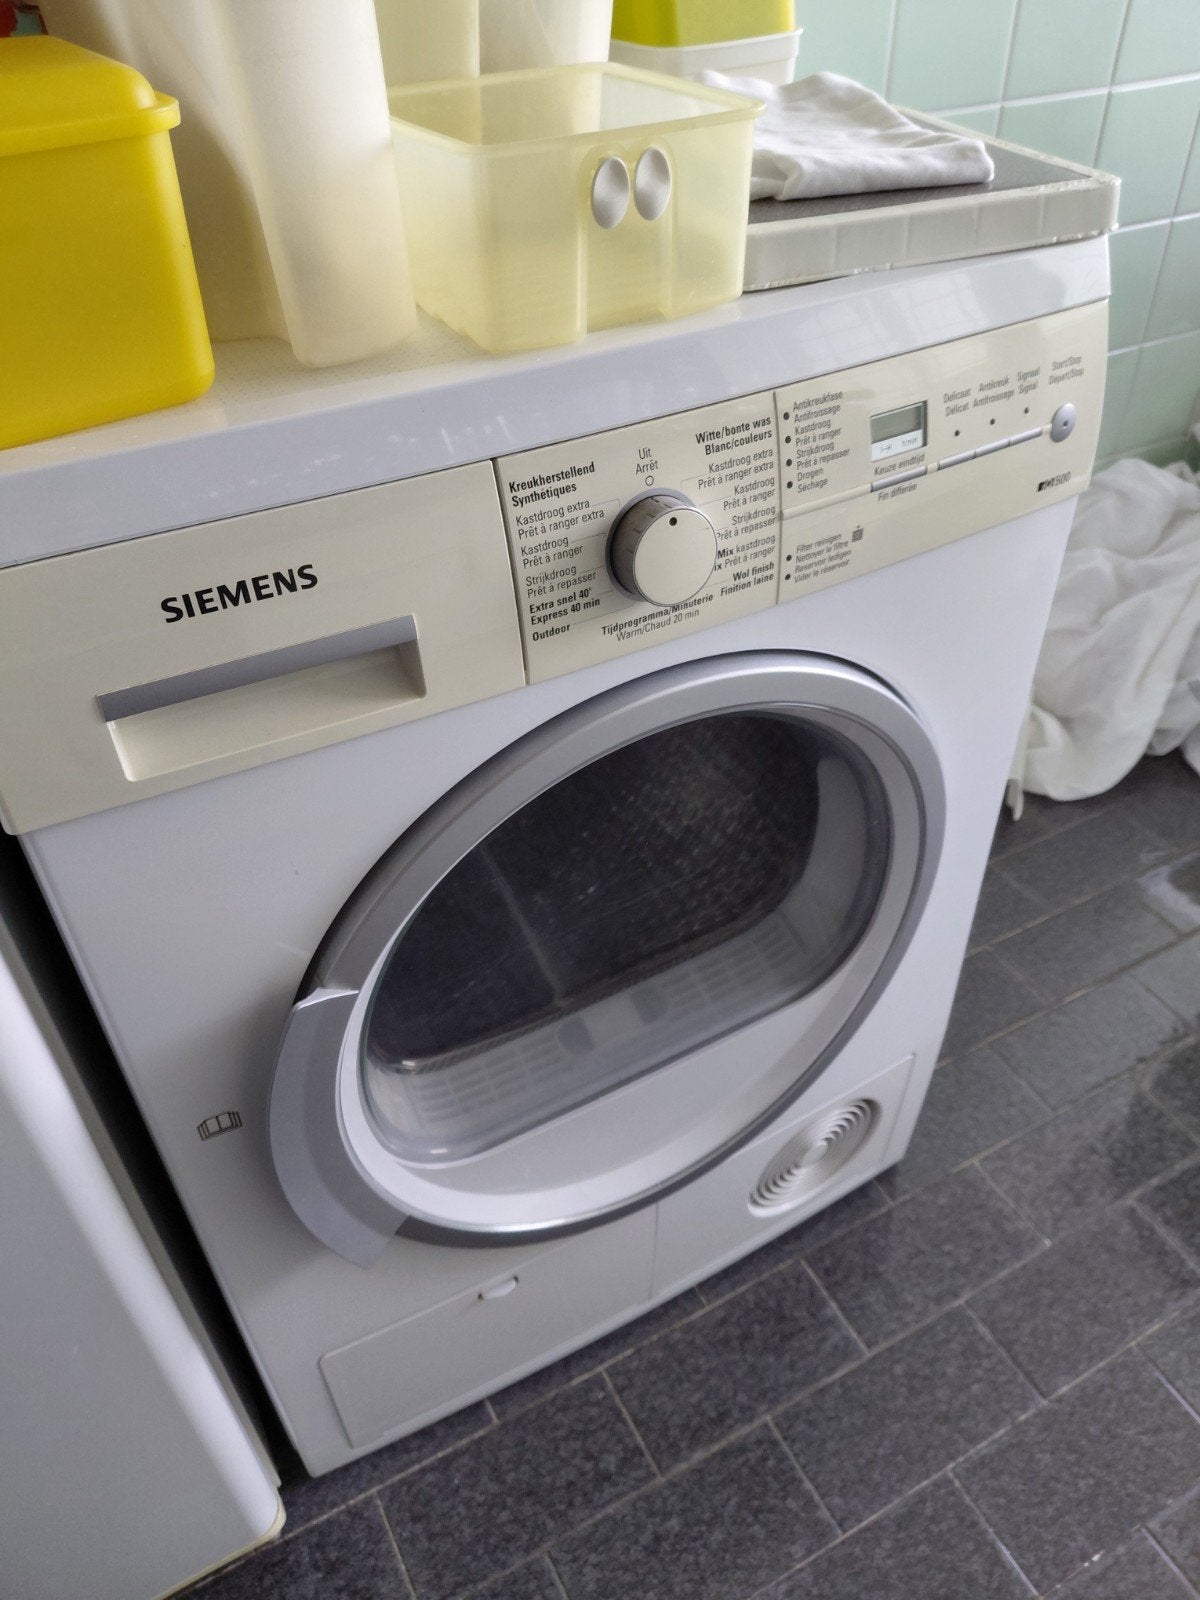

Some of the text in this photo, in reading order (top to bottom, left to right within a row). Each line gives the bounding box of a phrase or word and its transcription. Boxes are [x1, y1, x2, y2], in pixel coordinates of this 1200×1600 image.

[979, 376, 1010, 392] Antikreuk
[1017, 367, 1041, 382] Signaal
[943, 387, 971, 404] Delicaat
[972, 389, 1015, 408] Antifroissage
[1018, 381, 1038, 396] Signal
[793, 391, 843, 411] Antikreukfase
[794, 404, 841, 423] Antifroissage
[695, 417, 771, 445] Witte/bonte was
[795, 419, 831, 436] Kastdroog
[795, 434, 811, 447] Prêt
[818, 427, 842, 441] ranger
[638, 447, 652, 460] Uit
[705, 430, 772, 456] Blanc/couleurs
[796, 441, 835, 459] Strijkdroog
[635, 460, 659, 475] Arrêt
[708, 448, 774, 474] Kastdroog extra
[796, 458, 811, 470] Prêt
[819, 448, 850, 464] repasser
[874, 452, 926, 477] Keuze eindtijd
[508, 461, 595, 494] Kreukherstellend
[698, 461, 774, 490] Prêt à ranger extra
[797, 467, 824, 482] Drogen
[512, 483, 577, 508] Synthétiques
[734, 477, 775, 496] Kastdroog
[878, 492, 889, 501] Fin
[723, 488, 776, 511] Prêt à ranger
[515, 500, 590, 527] Kastdroog extra
[732, 506, 776, 526] Strijkdroog
[518, 509, 605, 540] Prêt à ranger extra
[734, 527, 739, 537] à
[741, 517, 776, 535] repasser
[520, 536, 569, 557] Kastdroog
[717, 535, 776, 559] Mix kastdroog
[795, 540, 849, 563] Nettoyer le filtre
[796, 533, 842, 554] Filter reinigen
[522, 545, 584, 569] Prêt à ranger
[724, 557, 741, 569] Prêt
[743, 554, 748, 563] à
[750, 546, 776, 560] ranger
[525, 566, 577, 587] Strijkdroog
[732, 561, 775, 582] Wol finish
[794, 572, 812, 583] Vider
[812, 569, 820, 578] le
[160, 563, 319, 624] SIEMENS
[527, 572, 597, 598] Prêt à repasser
[720, 573, 774, 597] Finition laine
[529, 600, 555, 614] Extra
[556, 592, 577, 606] snel
[530, 598, 601, 626] Express 40 min
[601, 593, 714, 636] Tijdprogramma/Minuterie
[616, 608, 700, 642] Warm/Chaud 20 min
[532, 624, 571, 642] Outdoor
